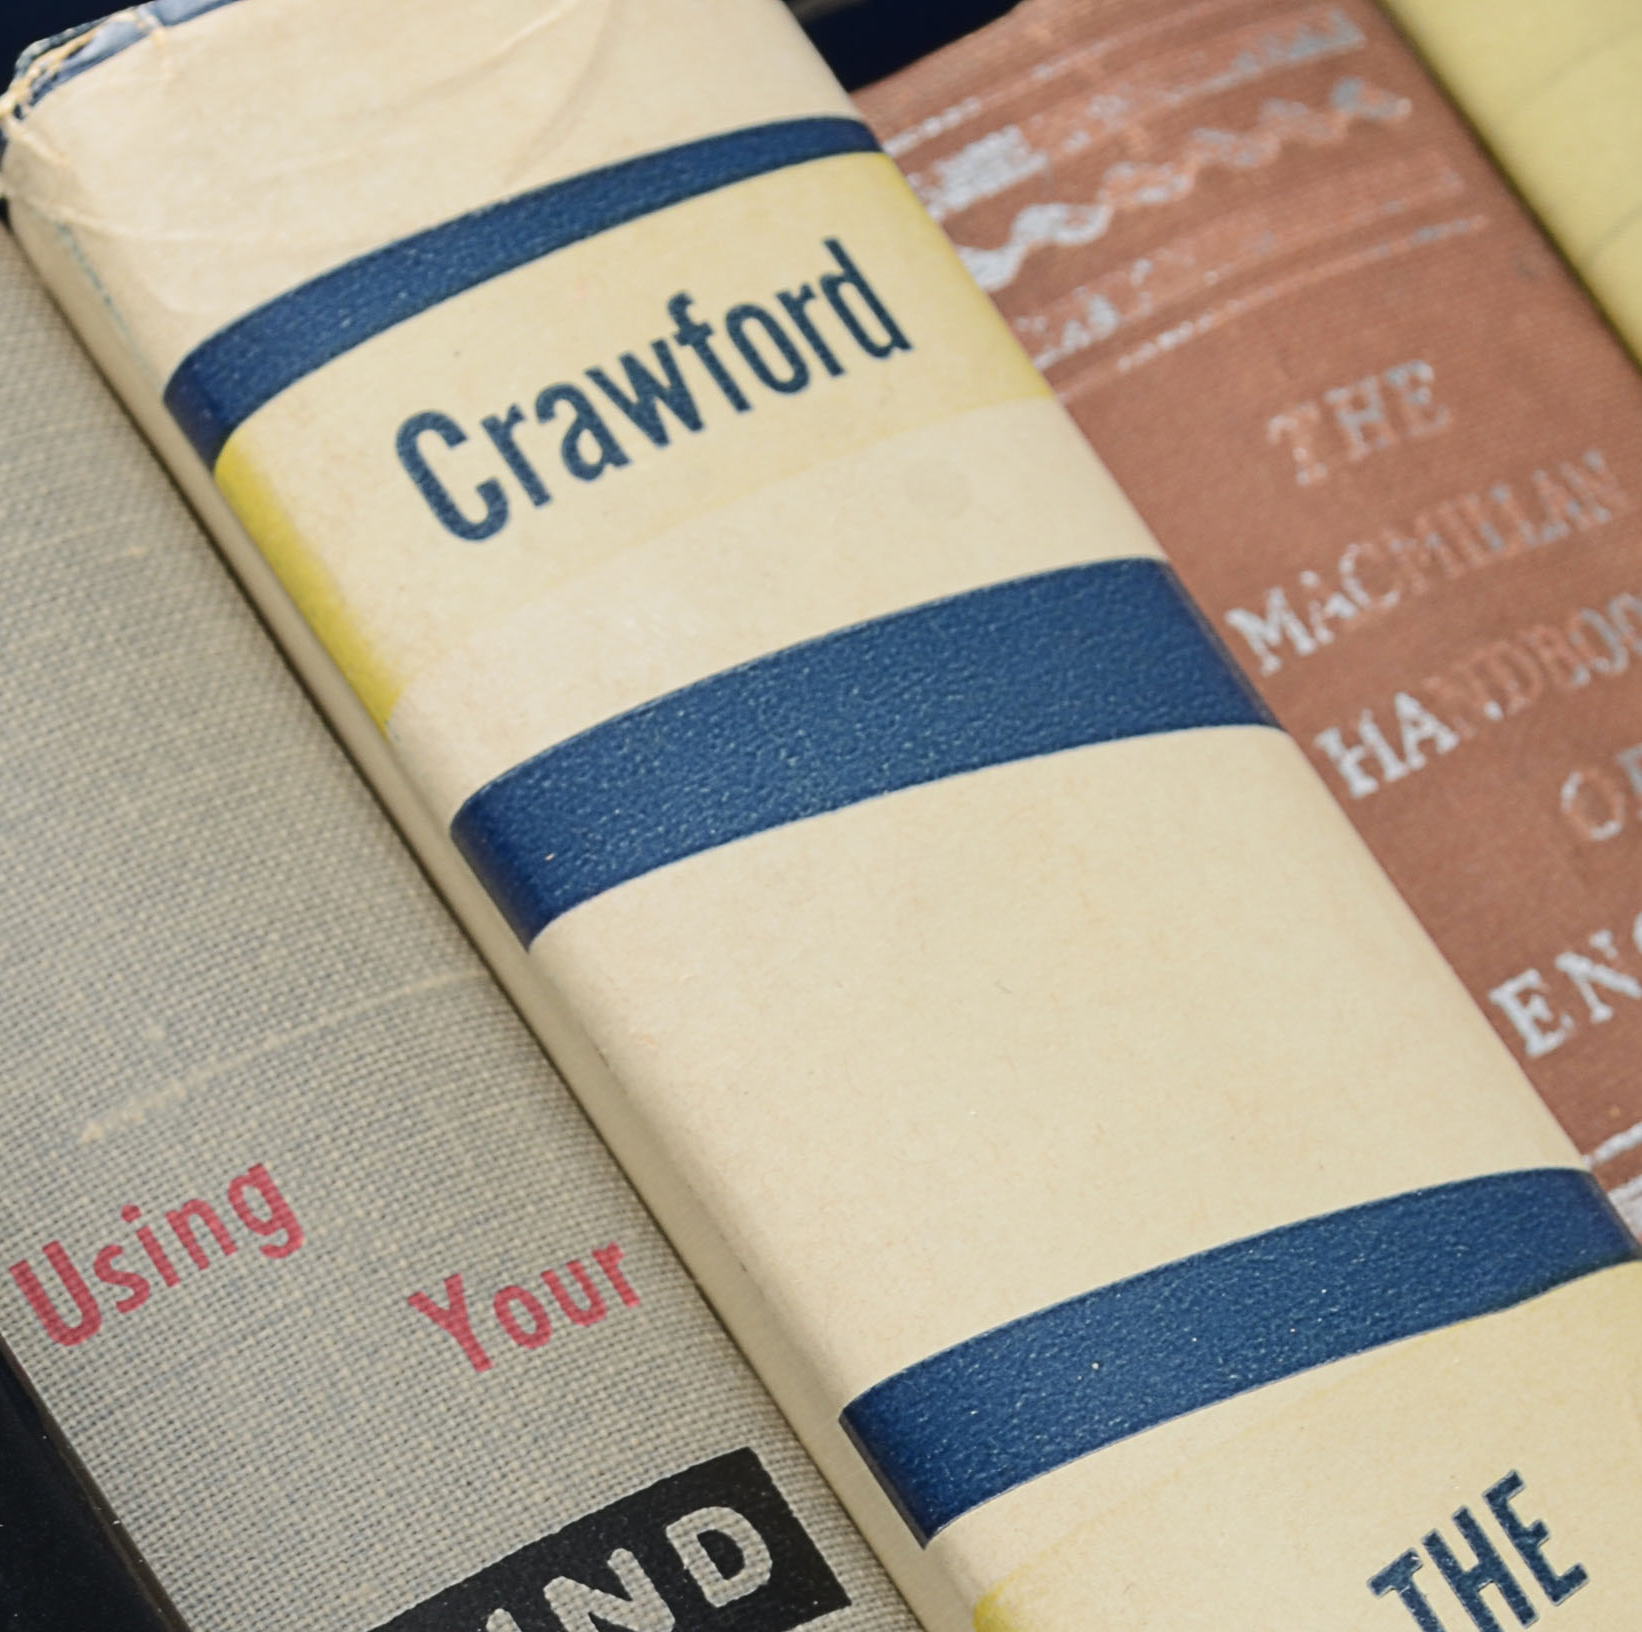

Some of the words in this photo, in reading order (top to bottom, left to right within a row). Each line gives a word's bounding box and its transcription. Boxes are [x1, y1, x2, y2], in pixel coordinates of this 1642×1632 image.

[394, 237, 915, 543] Crawford
[1267, 359, 1453, 487] THE
[1224, 448, 1632, 677] MACMILLAN
[8, 1162, 305, 1347] Using
[407, 1243, 642, 1372] Your
